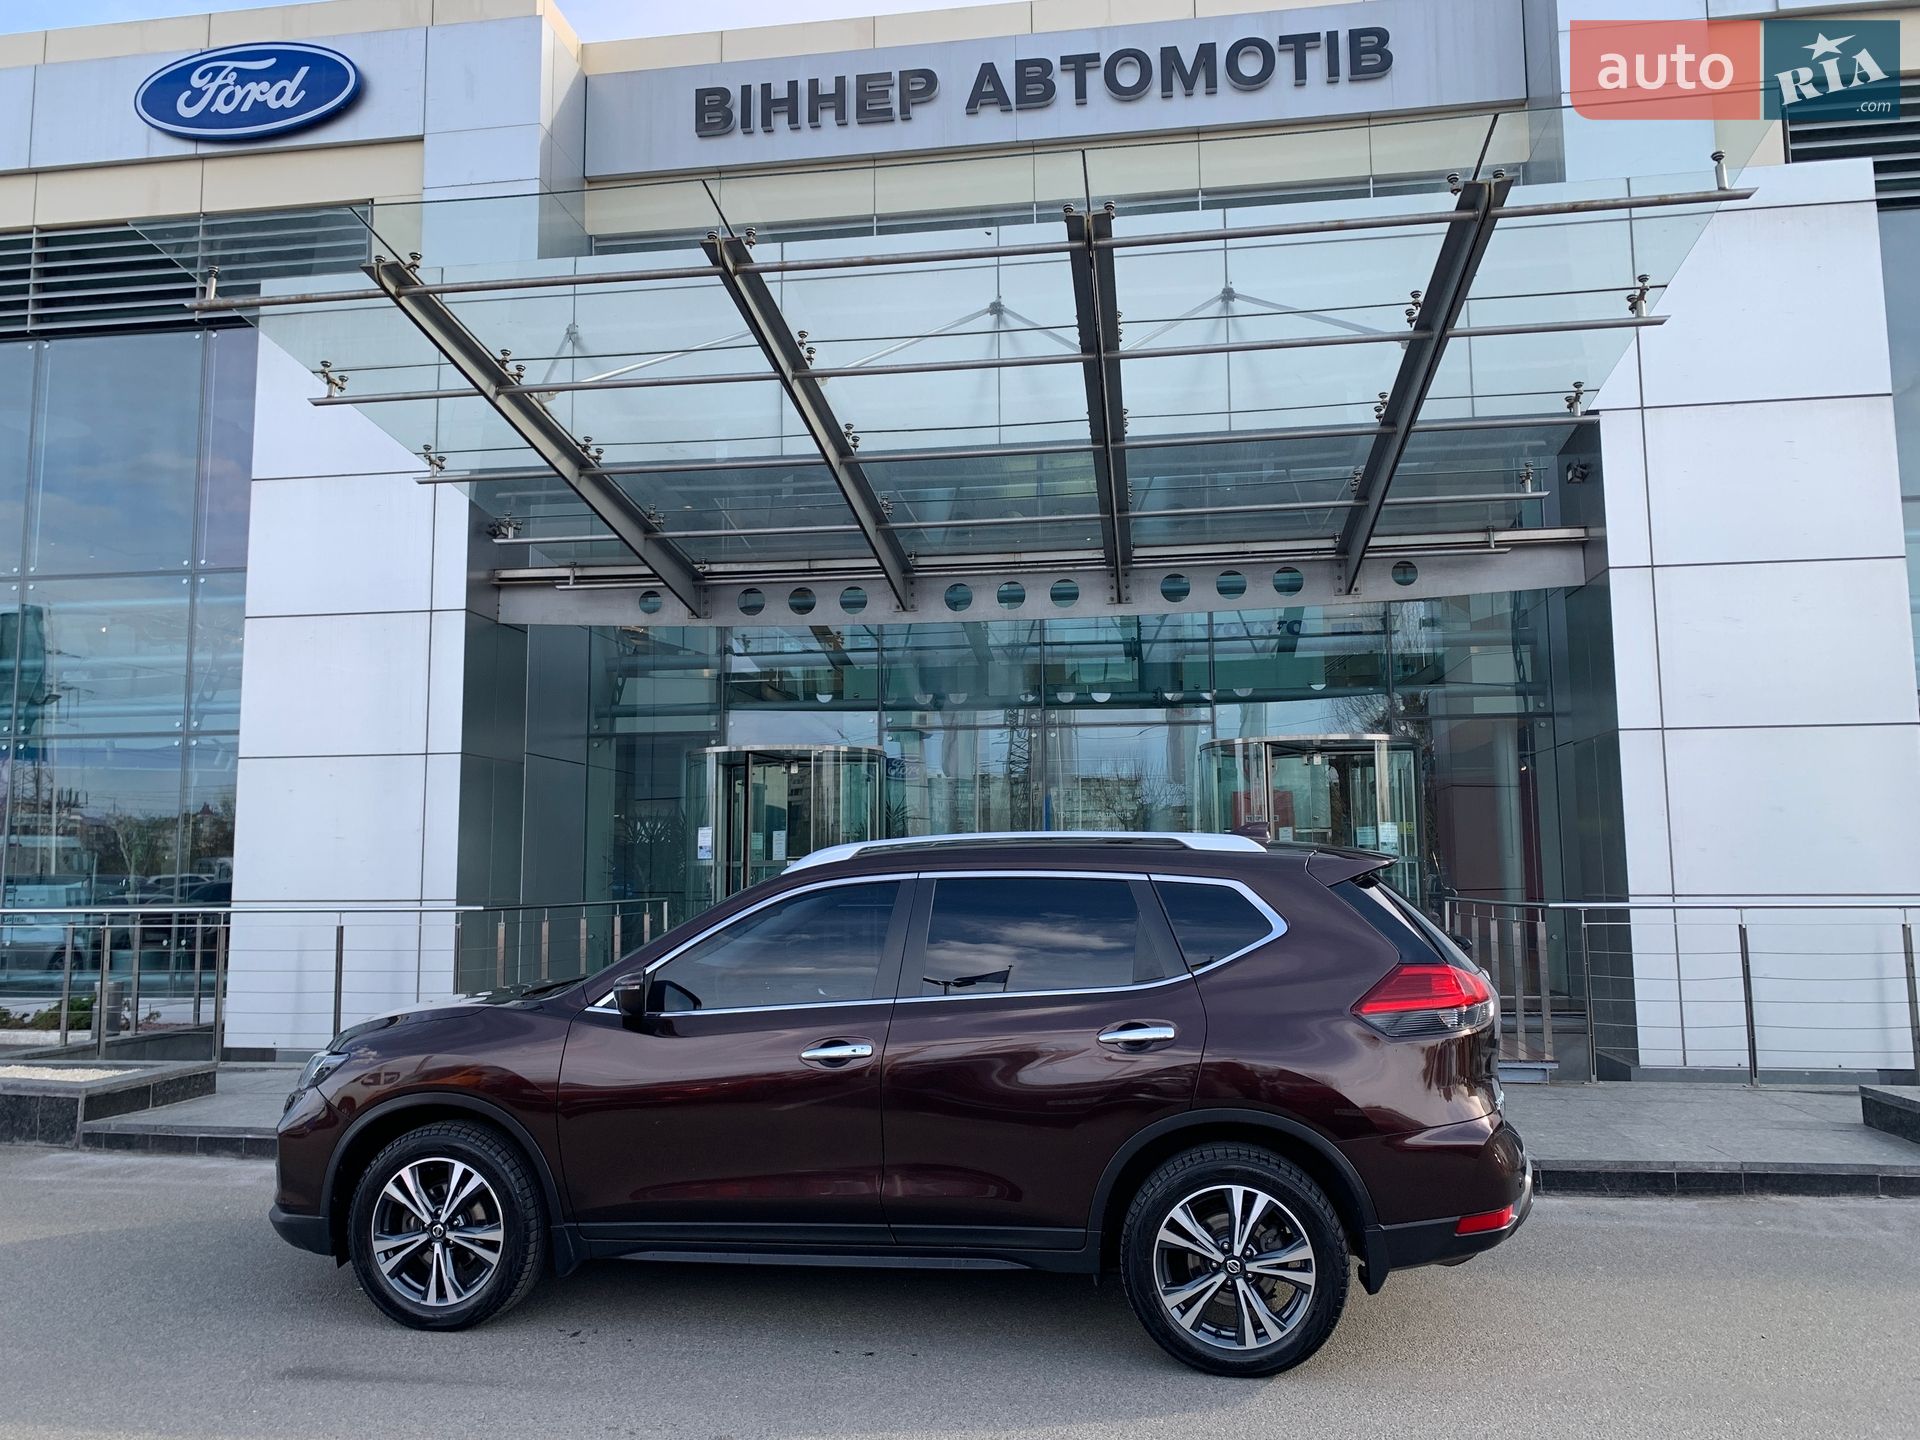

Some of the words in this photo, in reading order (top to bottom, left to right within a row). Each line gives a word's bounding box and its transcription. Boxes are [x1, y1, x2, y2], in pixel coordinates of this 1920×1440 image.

[176, 57, 310, 118] Ford
[694, 68, 939, 137] ВІННЕР
[965, 26, 1394, 115] АВТОМОТІВ
